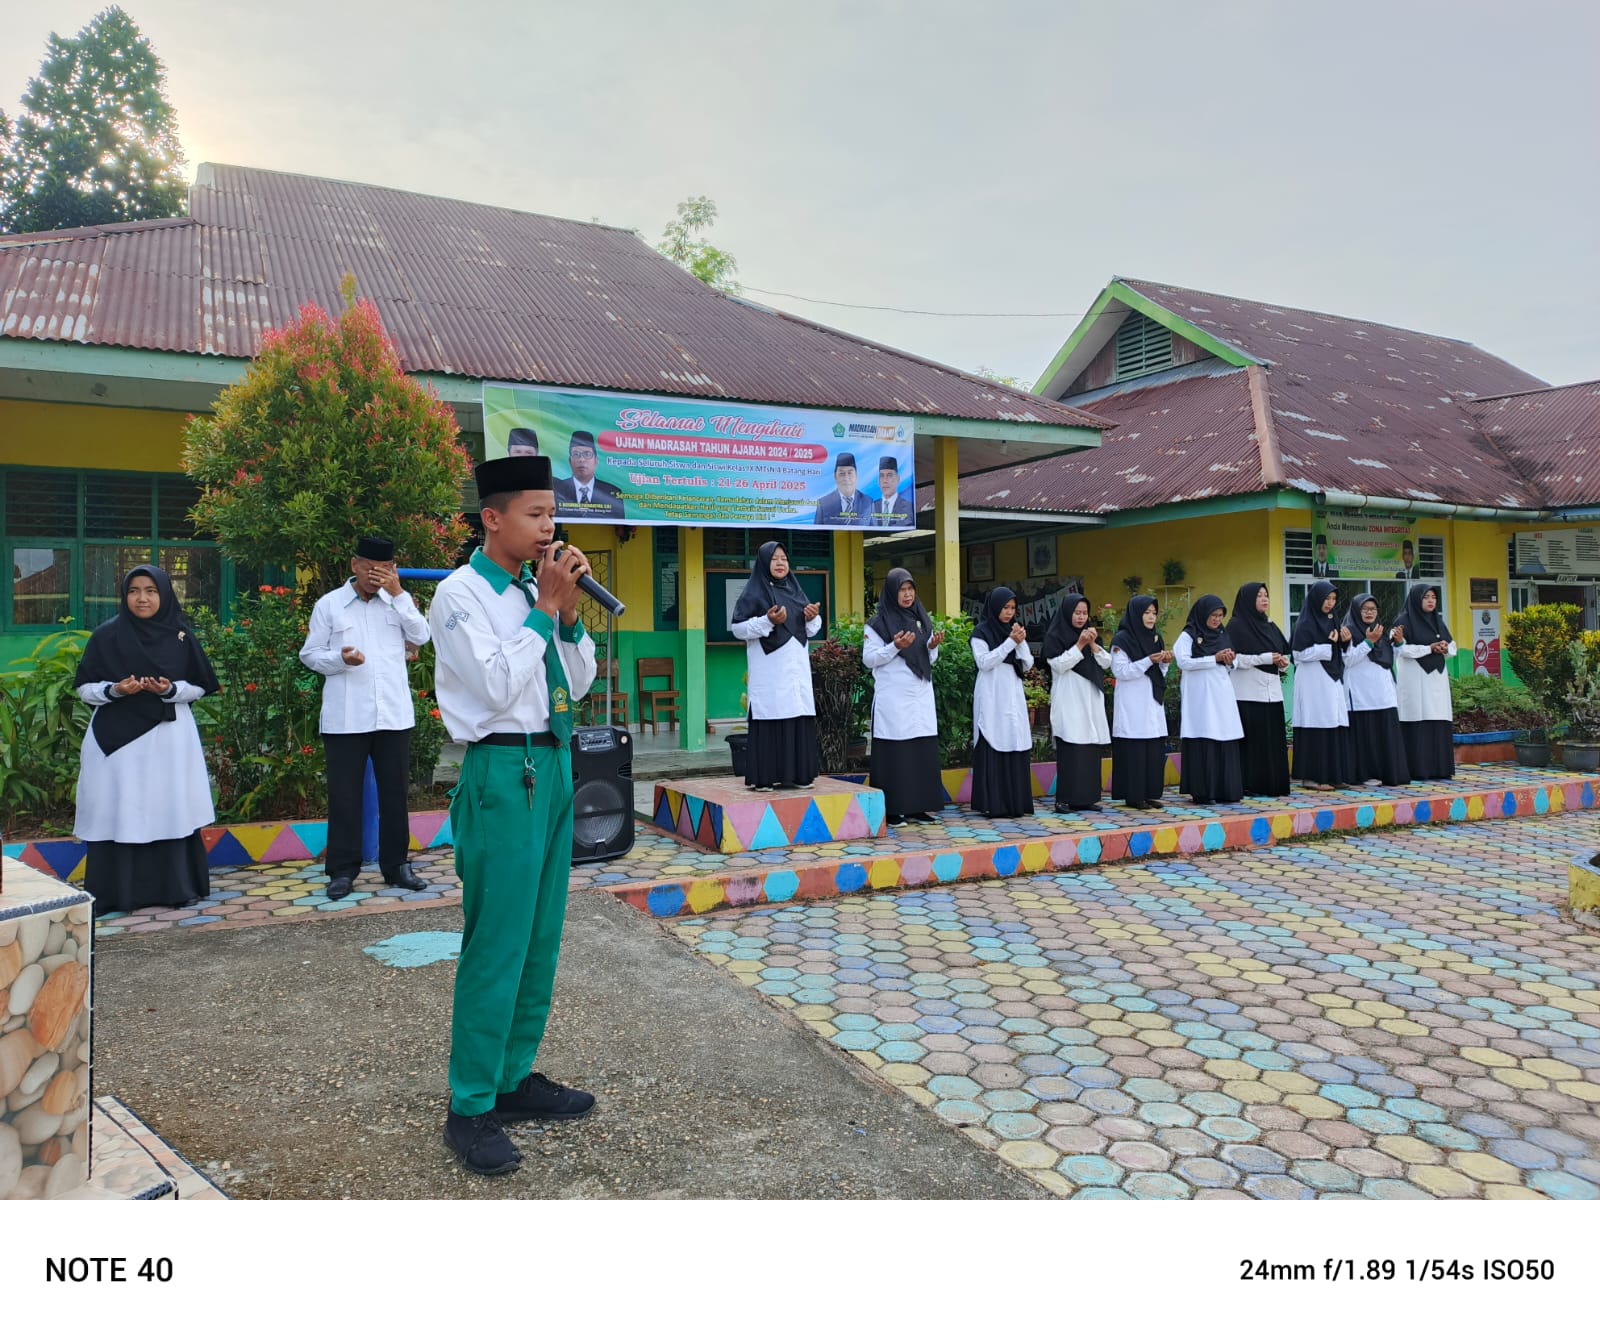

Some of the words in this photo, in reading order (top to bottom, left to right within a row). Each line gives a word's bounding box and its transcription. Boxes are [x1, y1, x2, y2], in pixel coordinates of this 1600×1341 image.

[616, 408, 706, 432] Selamat
[709, 415, 805, 441] Mengikuti
[848, 423, 877, 434] MADRASAH
[615, 436, 645, 449] UJIAN
[646, 438, 698, 453] MADRASAH
[699, 441, 730, 455] TAHUN
[732, 444, 767, 457] AJARAN
[768, 446, 788, 458] 2024
[793, 448, 814, 459] 2025
[607, 456, 636, 468] Kepada
[638, 458, 668, 469] Seluruh
[669, 460, 690, 470] Siswa
[692, 461, 706, 470] dan
[707, 463, 726, 471] Siswi
[727, 464, 746, 473] Kelas
[756, 465, 775, 474] MTsN
[782, 468, 806, 477] Batang
[629, 472, 661, 487] Ujian
[663, 474, 709, 487] Tertulis
[717, 477, 749, 490] 21-26
[751, 480, 777, 492] April
[780, 481, 806, 491] 2025
[616, 491, 643, 501] Semoga
[645, 493, 677, 502] Diberikan
[653, 503, 699, 511] Mendapatkan
[717, 505, 732, 513] yang
[665, 511, 682, 519] Tetap
[683, 512, 715, 520] Semangat
[1327, 521, 1341, 531] Anda
[1341, 523, 1368, 532] Memasuki
[1368, 525, 1383, 533] ZONA
